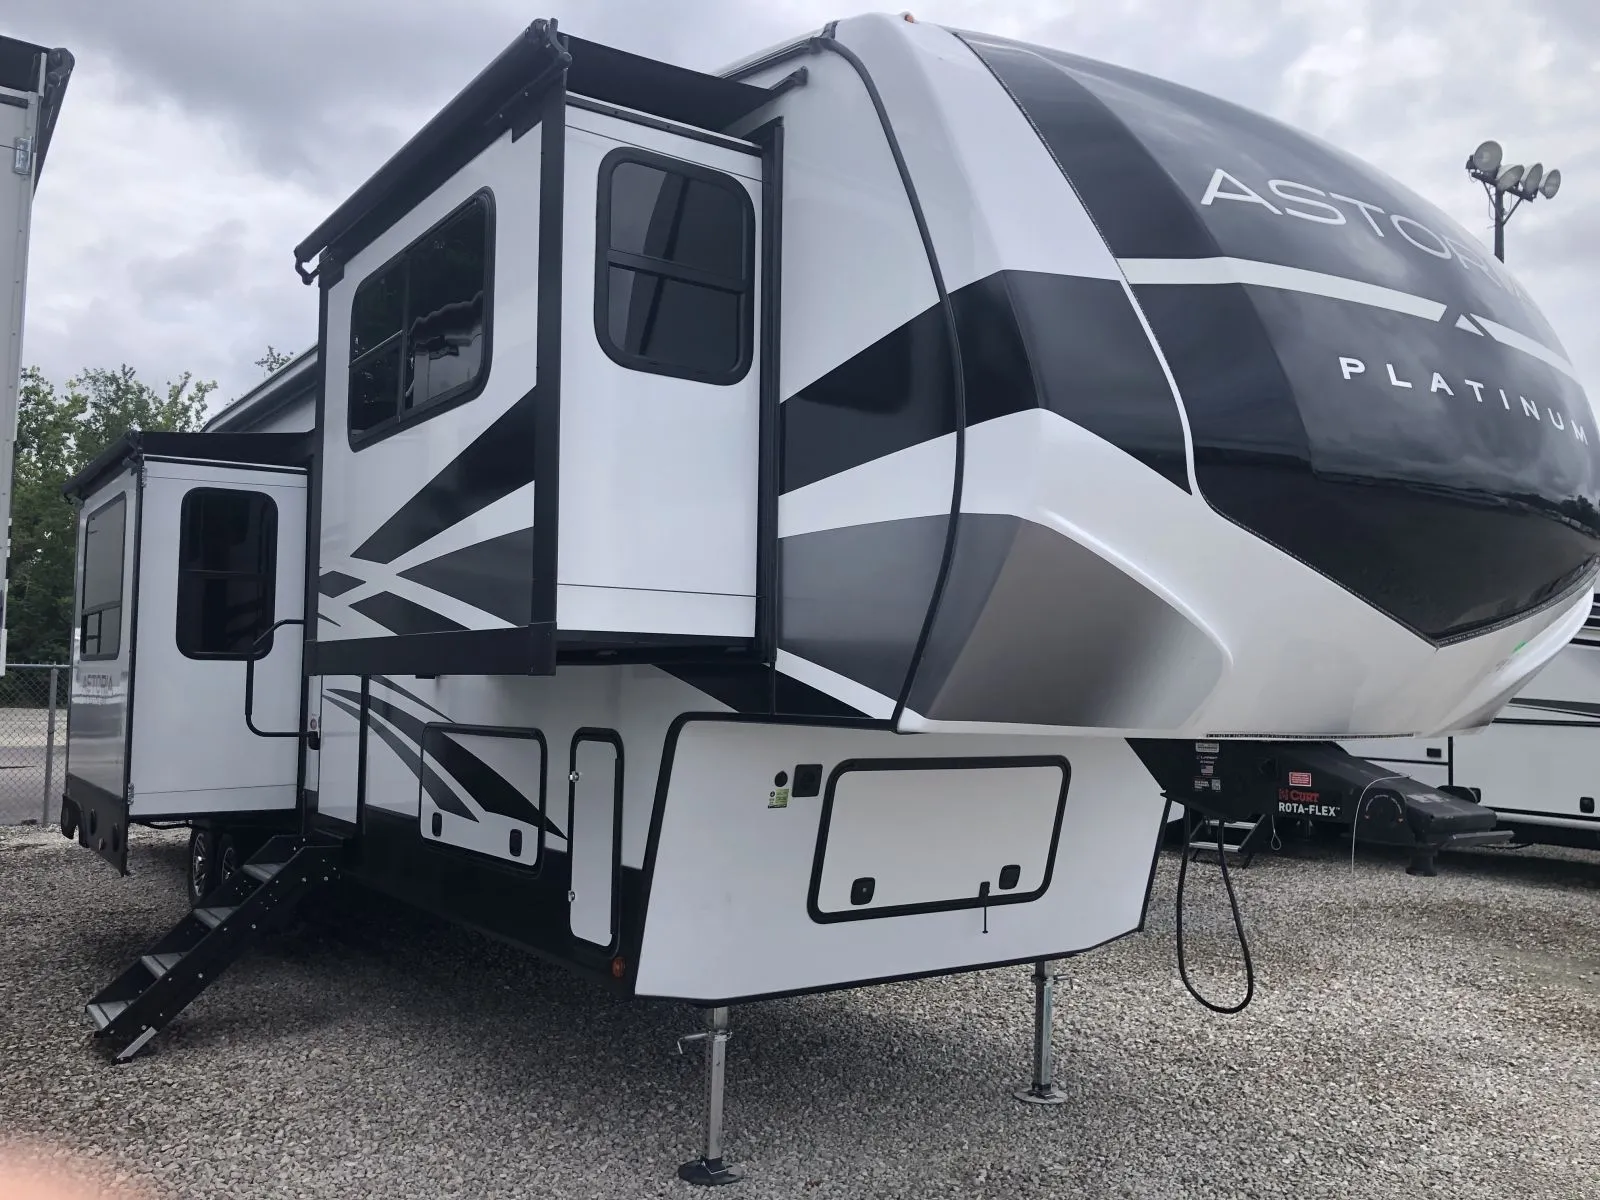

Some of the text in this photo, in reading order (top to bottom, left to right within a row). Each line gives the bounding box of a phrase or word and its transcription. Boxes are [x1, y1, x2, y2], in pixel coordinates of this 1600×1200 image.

[1201, 168, 1531, 303] ASTOR
[1338, 356, 1588, 445] PLATINUM
[1289, 789, 1320, 803] CURT
